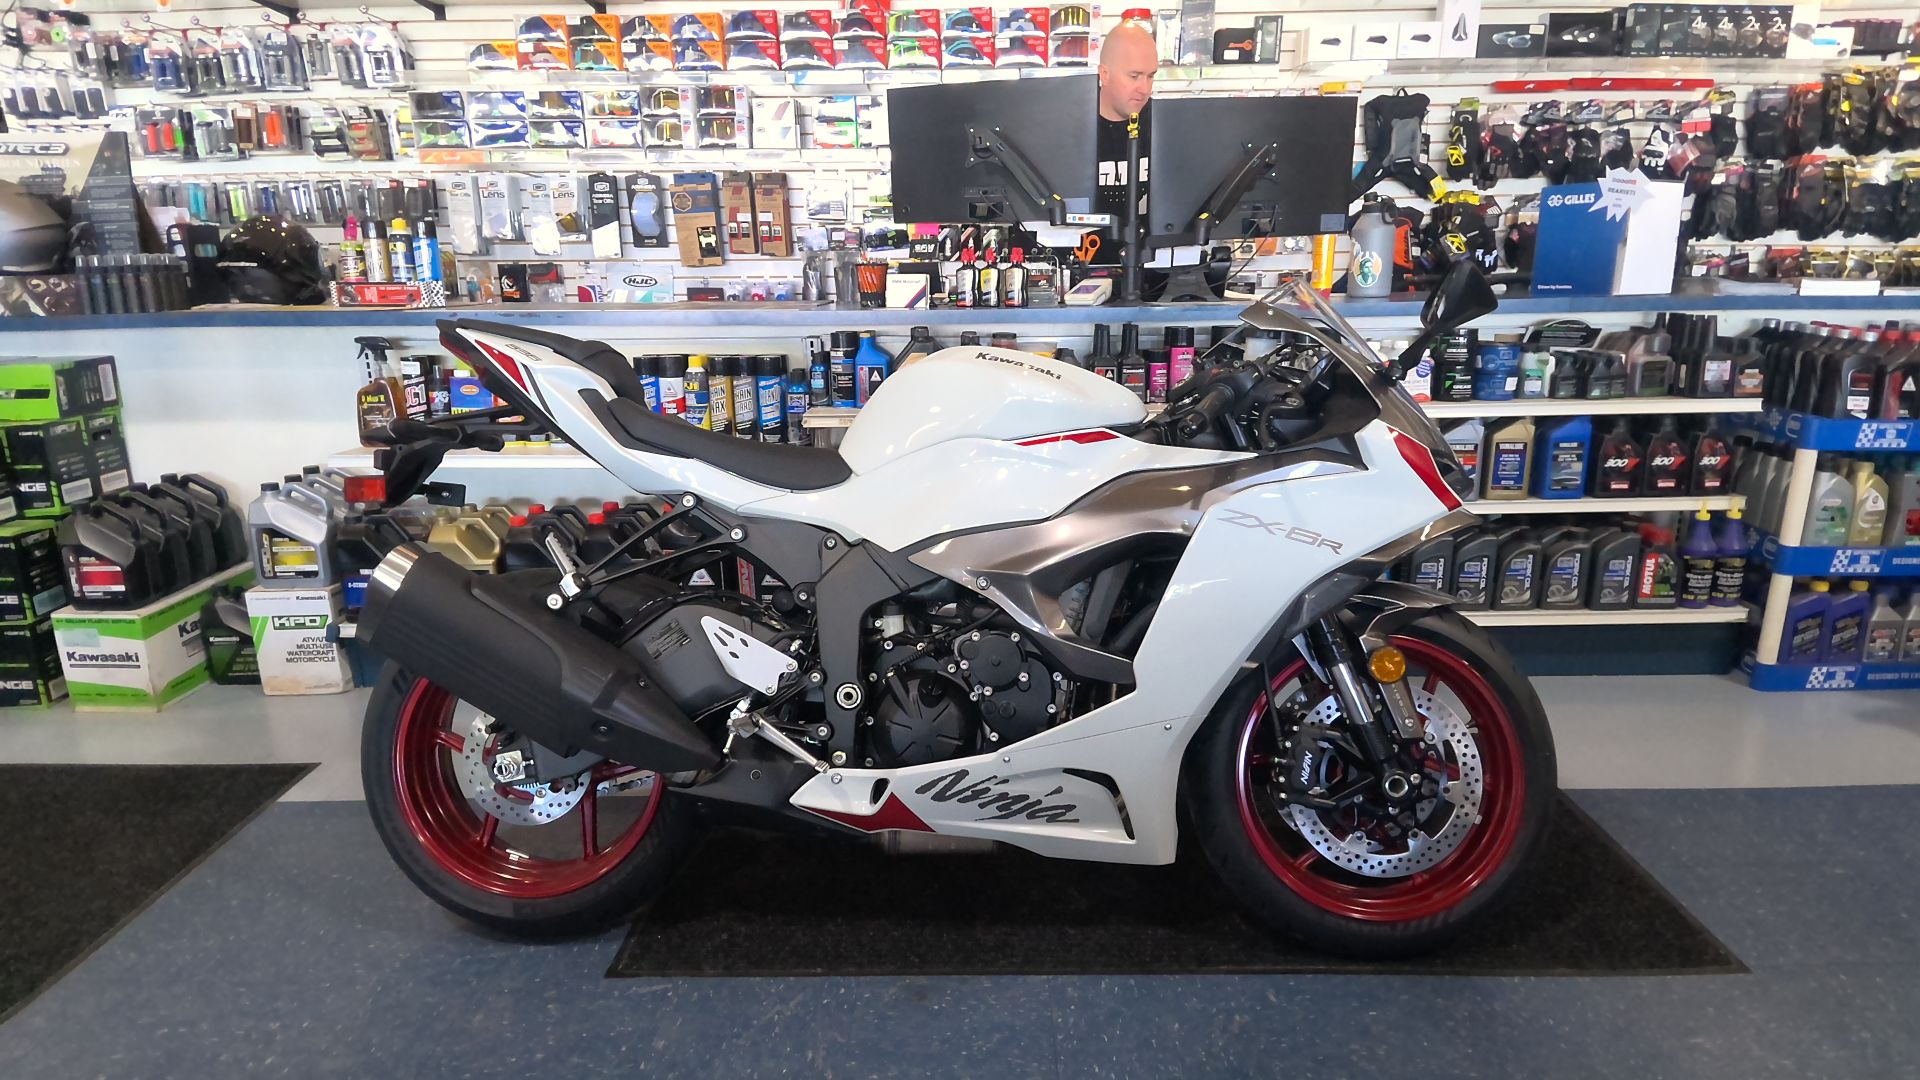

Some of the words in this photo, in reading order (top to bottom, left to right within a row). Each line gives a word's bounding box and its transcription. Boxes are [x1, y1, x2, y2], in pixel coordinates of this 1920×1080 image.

[482, 190, 505, 199] Lens
[552, 190, 575, 199] Lens
[1564, 193, 1595, 205] GILLES
[627, 276, 653, 286] HJC
[734, 386, 752, 400] HAIN
[1216, 508, 1343, 555] ZX-6R
[1481, 557, 1489, 579] FORK
[1526, 554, 1534, 577] FORK
[1573, 553, 1581, 577] FORK
[1625, 555, 1633, 577] FORK
[1642, 558, 1655, 595] MOTUL
[66, 651, 140, 663] Kawasaki
[287, 649, 334, 657] WATERCRAFT
[1300, 751, 1313, 785] NISSIN
[915, 769, 1080, 823] Ninja
